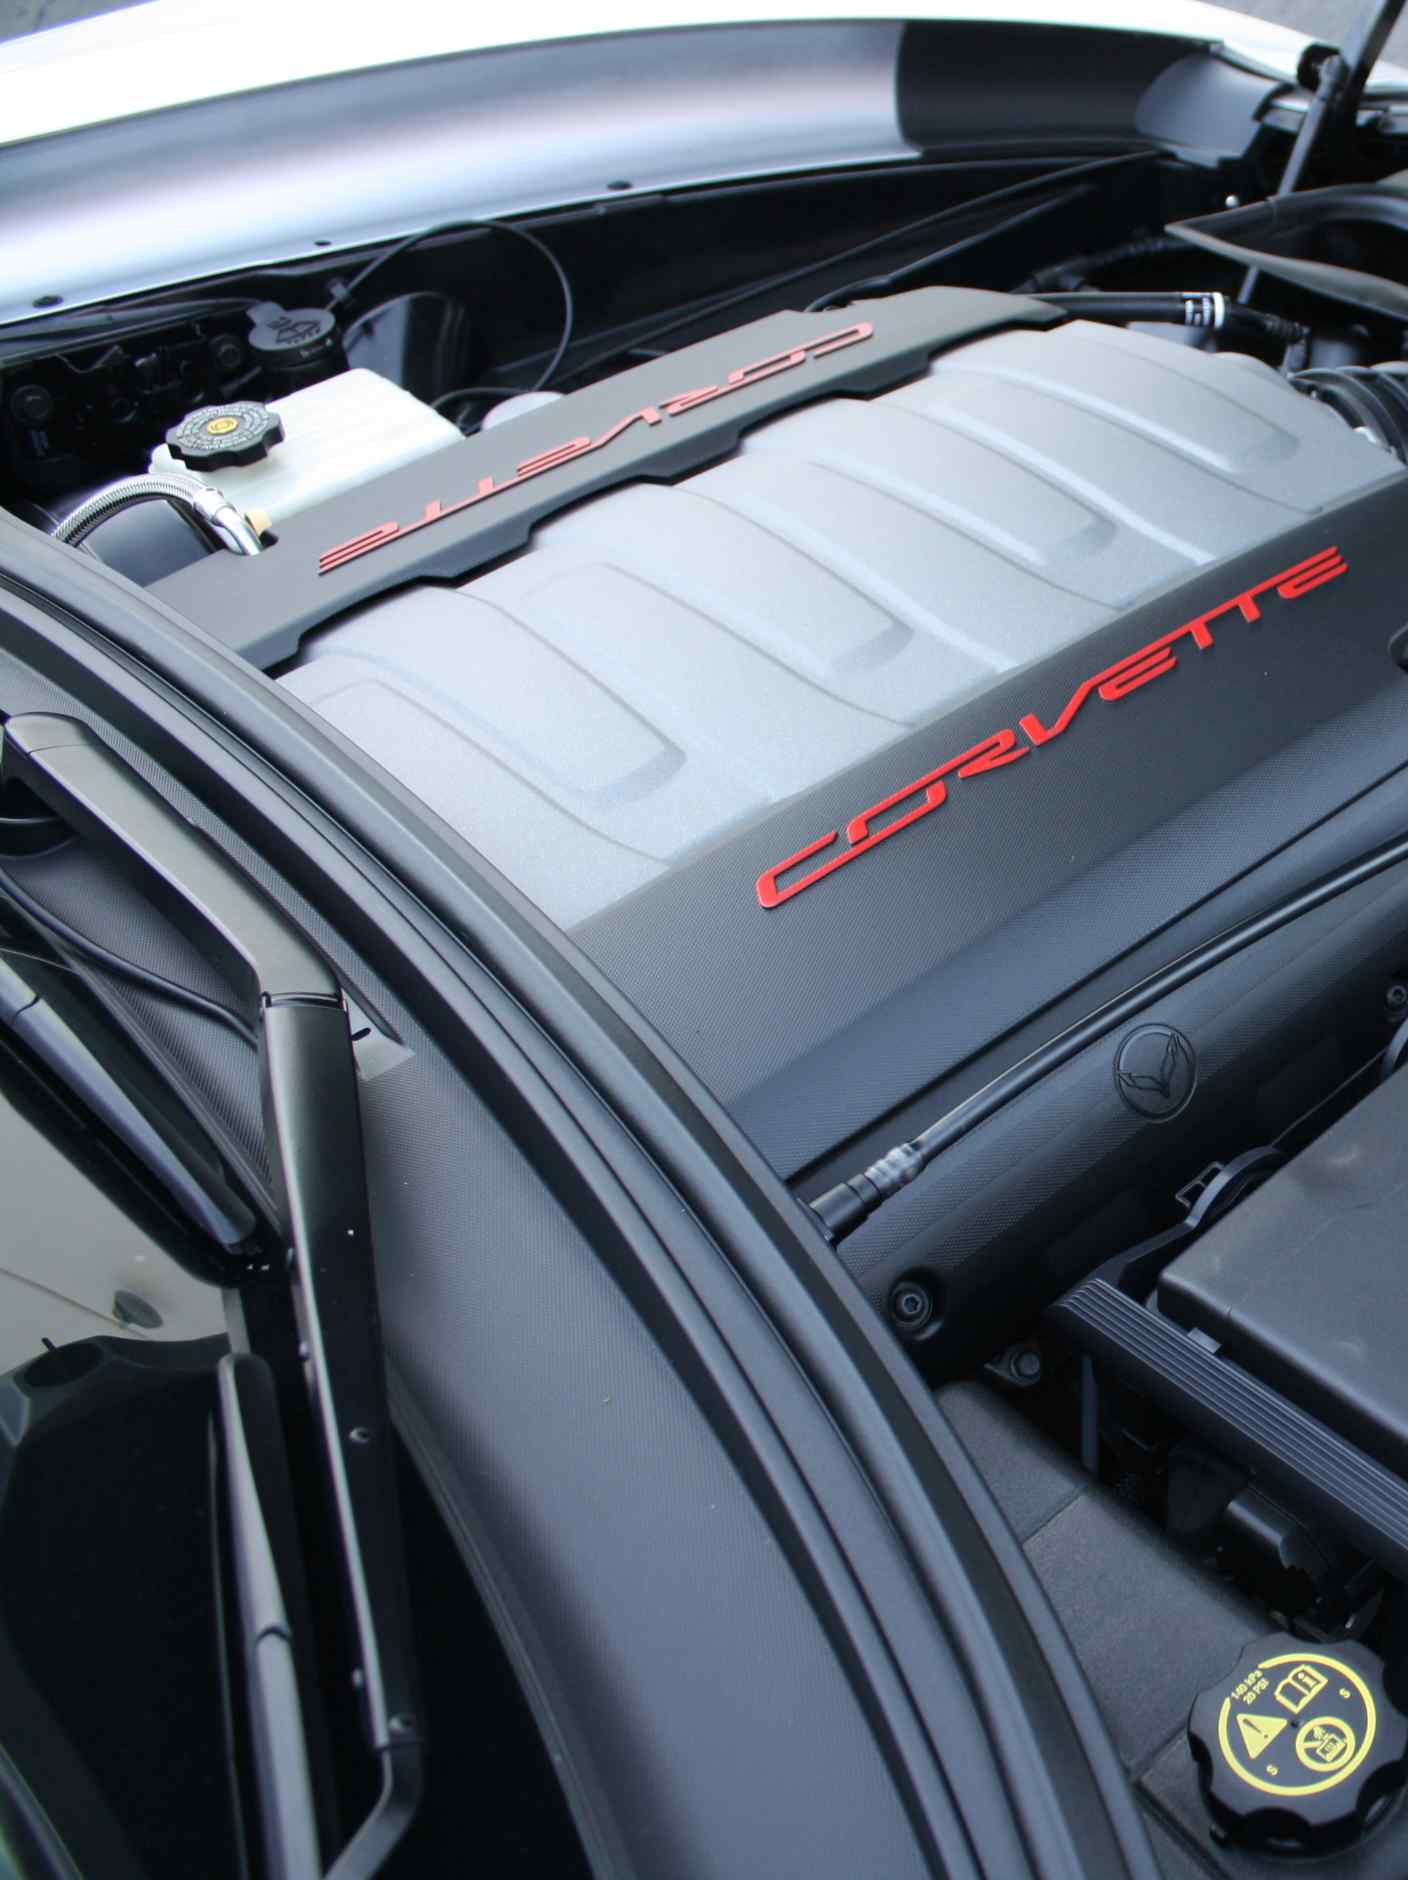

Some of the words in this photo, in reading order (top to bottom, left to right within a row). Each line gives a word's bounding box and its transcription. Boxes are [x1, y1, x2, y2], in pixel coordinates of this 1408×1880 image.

[318, 321, 874, 575] CORVETTE
[756, 545, 1349, 910] CORVETTE
[1231, 1683, 1248, 1700] 140
[1243, 1691, 1257, 1705] 20
[1252, 1677, 1269, 1695] PSI
